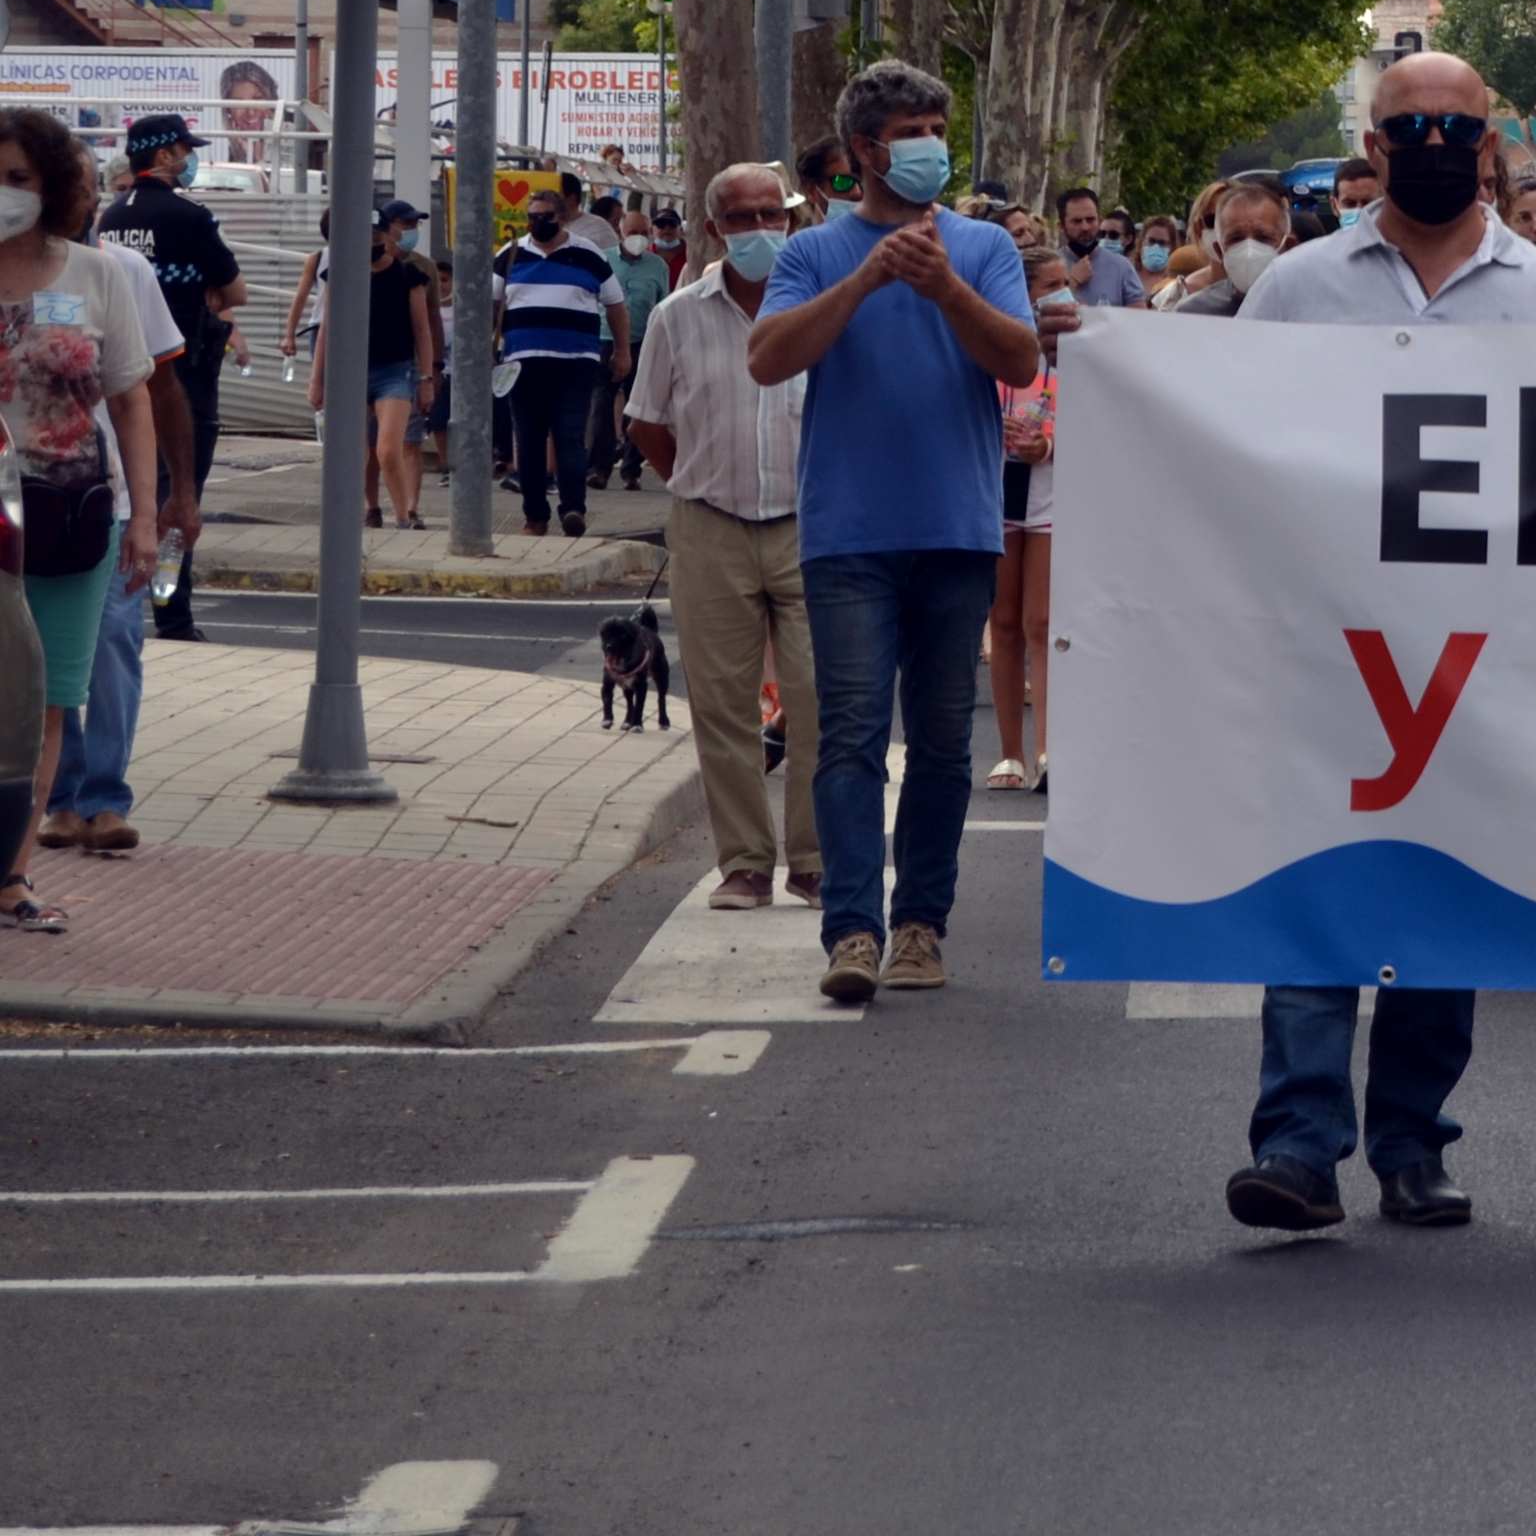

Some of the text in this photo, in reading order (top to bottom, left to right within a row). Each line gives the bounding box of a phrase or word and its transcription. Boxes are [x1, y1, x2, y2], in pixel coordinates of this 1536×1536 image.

[70, 64, 200, 81] CORPODENTAL
[577, 127, 613, 138] HOGAR
[1342, 628, 1488, 813] y
